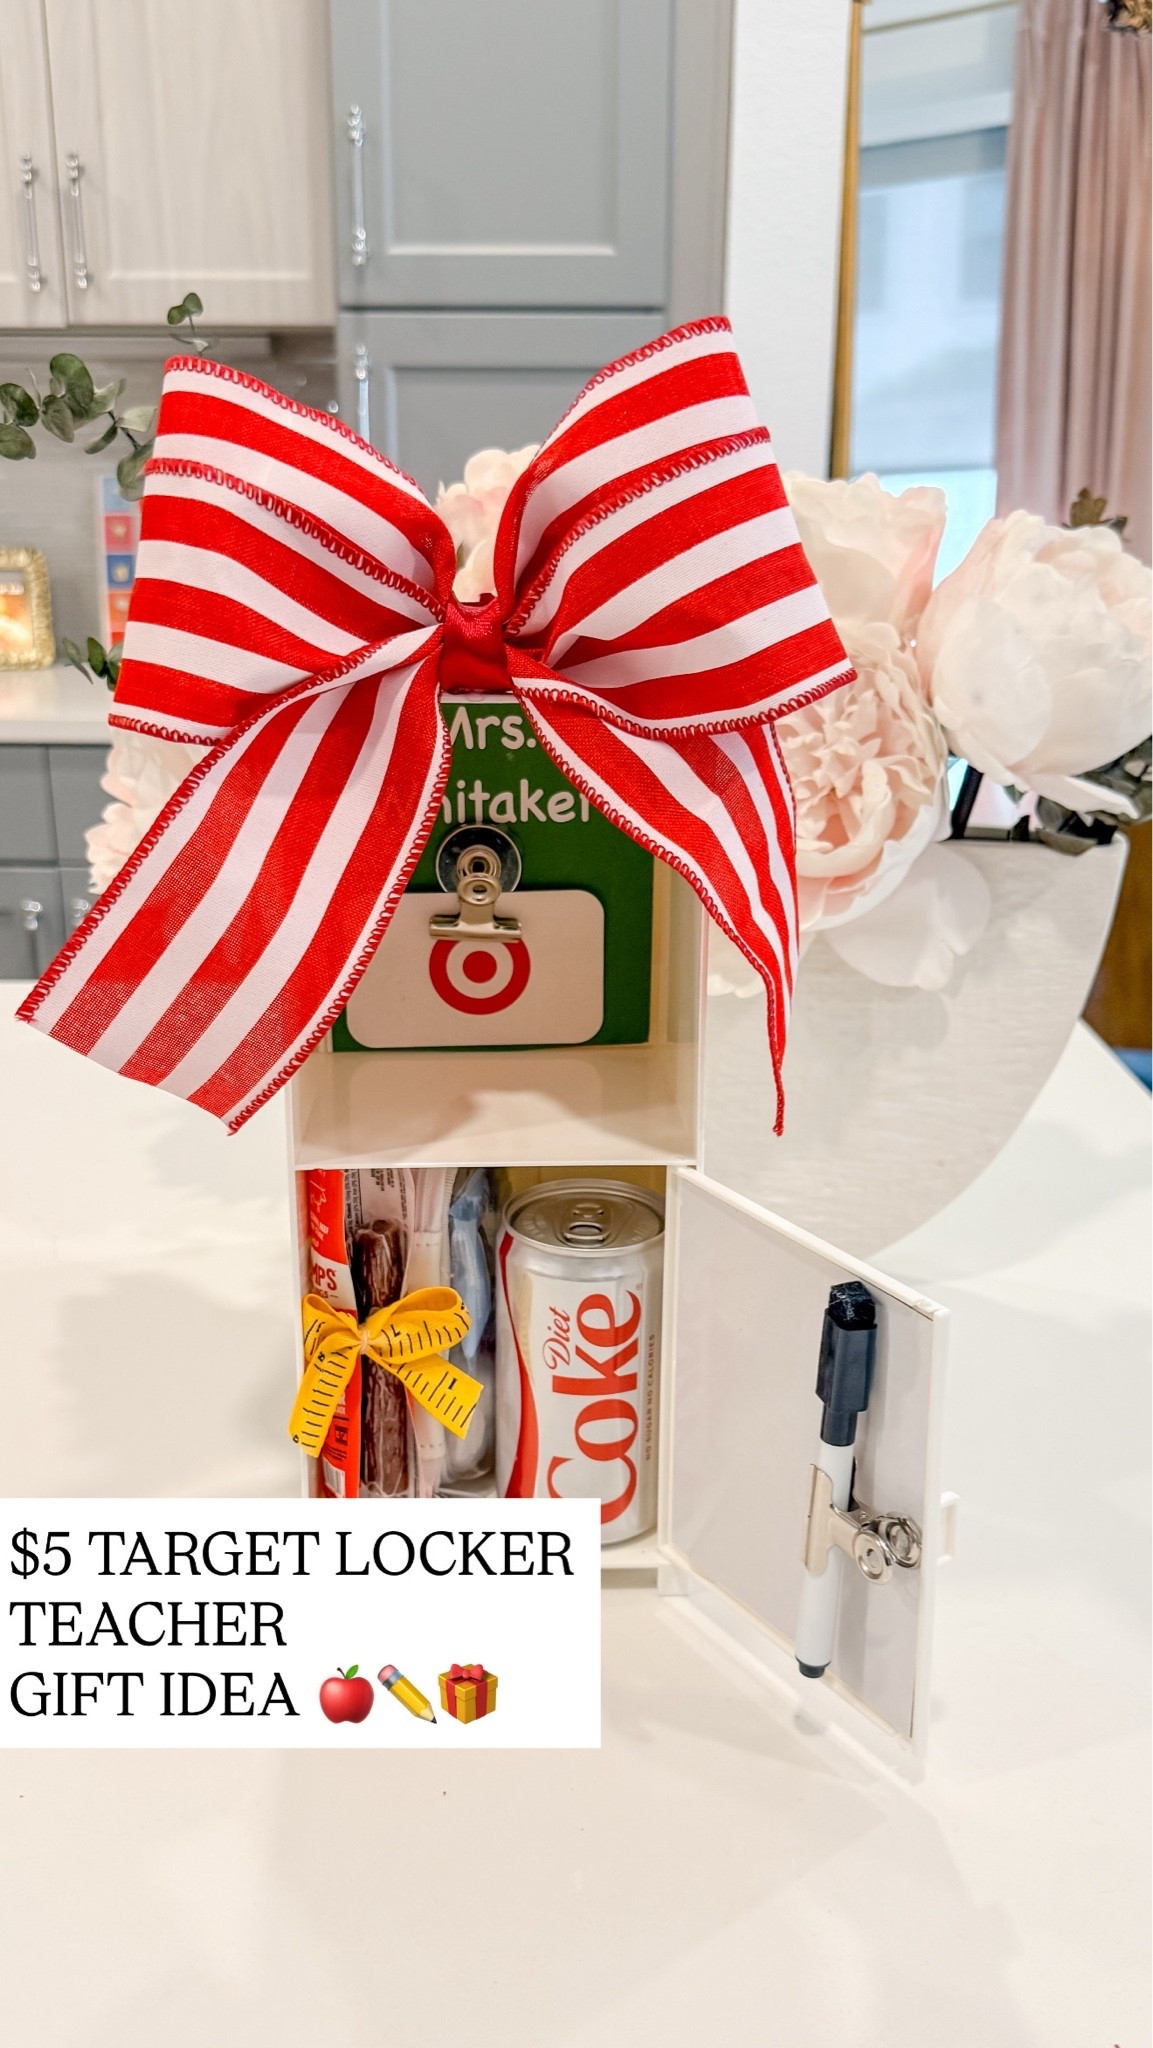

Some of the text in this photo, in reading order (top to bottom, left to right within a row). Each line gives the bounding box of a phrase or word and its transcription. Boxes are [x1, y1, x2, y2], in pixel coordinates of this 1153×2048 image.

[441, 778, 590, 824] itaker
[542, 1305, 571, 1370] Diet
[647, 1334, 656, 1387] CALORIES
[546, 1289, 642, 1525] Coke
[646, 1389, 653, 1405] NO
[645, 1408, 653, 1442] SUGAR
